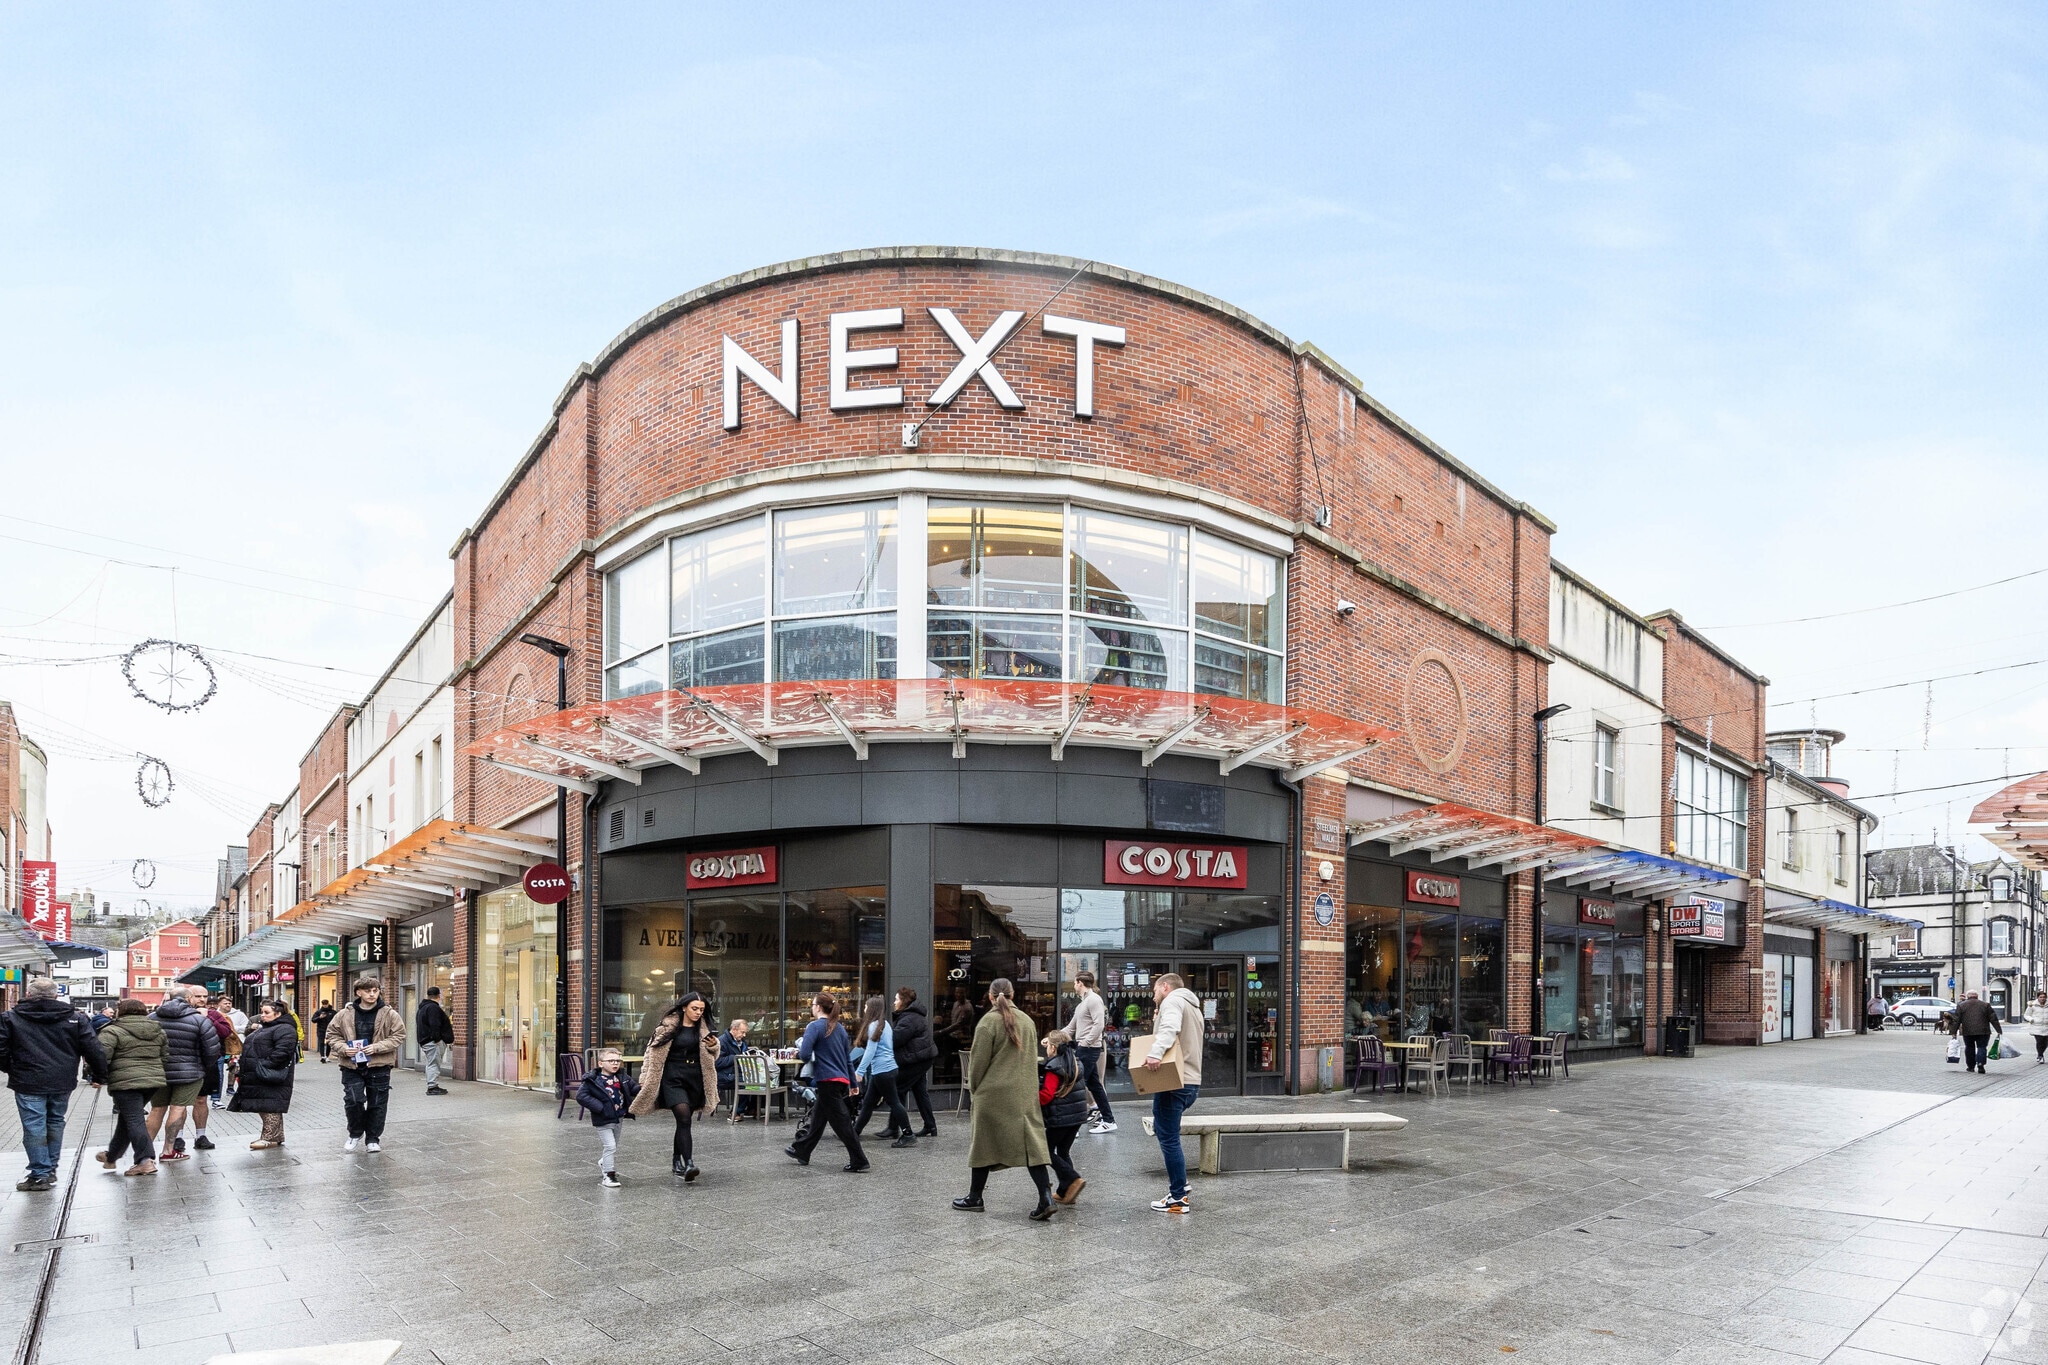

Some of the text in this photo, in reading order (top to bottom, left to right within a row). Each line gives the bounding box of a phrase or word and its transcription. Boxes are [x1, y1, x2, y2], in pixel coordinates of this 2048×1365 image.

[722, 307, 1127, 432] NEXT
[689, 853, 766, 880] COSTA
[1119, 845, 1238, 881] COSTA
[530, 878, 566, 888] COSTA
[1415, 877, 1458, 899] COSTA
[1672, 907, 1697, 921] DW
[1670, 920, 1700, 928] SPORTS
[1670, 927, 1700, 935] STORES
[373, 926, 383, 961] NEXT
[412, 922, 434, 950] NEXT
[320, 948, 335, 960] D
[241, 973, 260, 981] HMV
